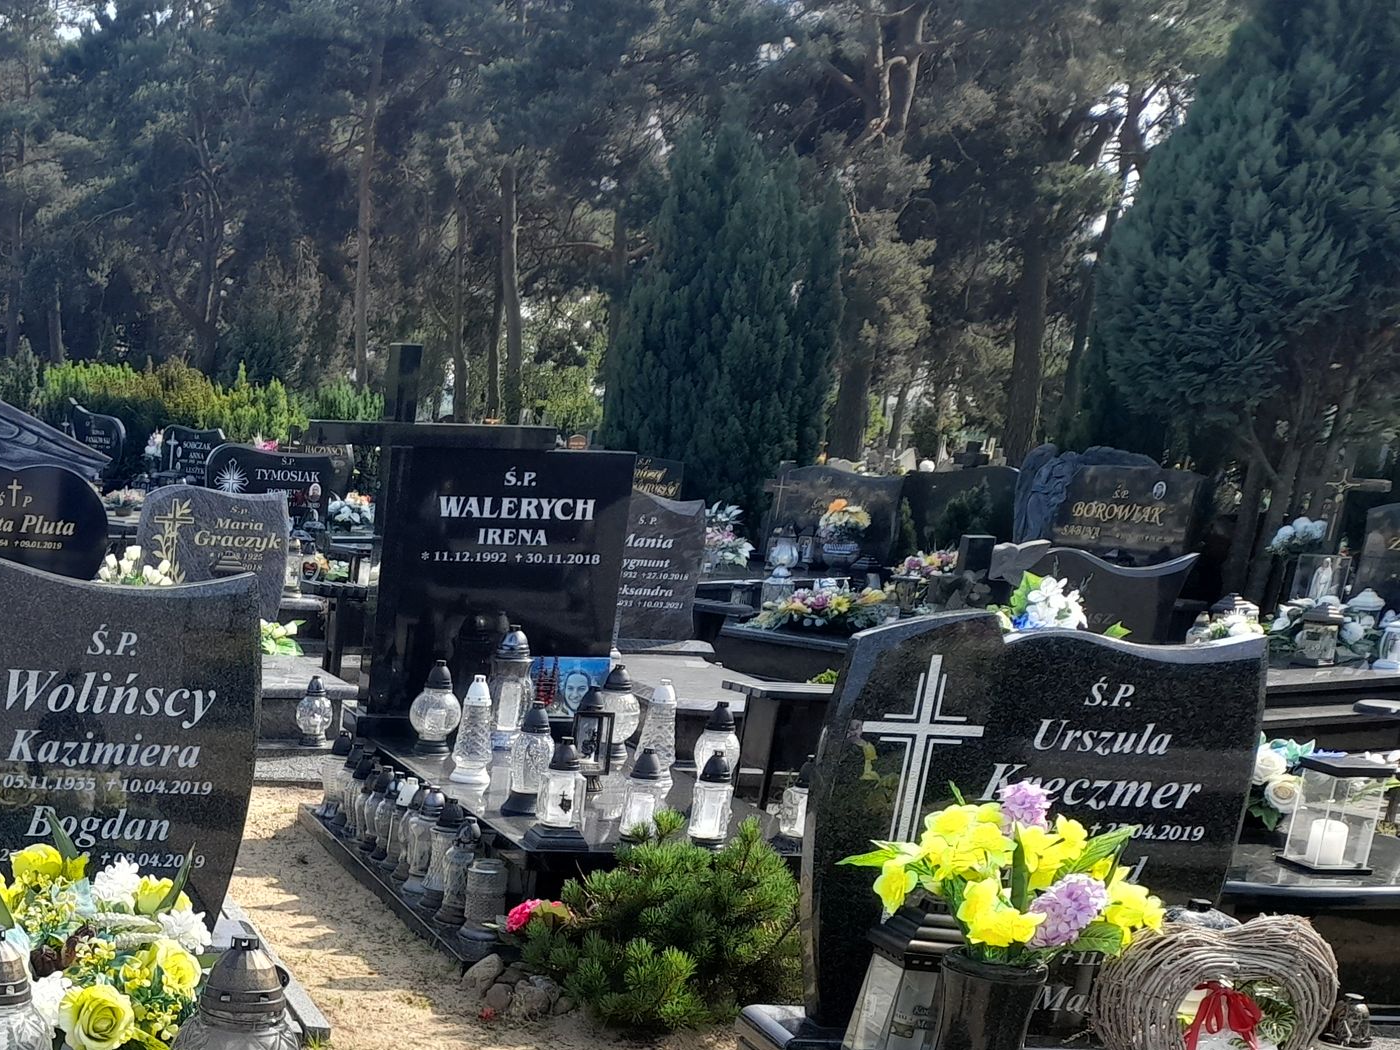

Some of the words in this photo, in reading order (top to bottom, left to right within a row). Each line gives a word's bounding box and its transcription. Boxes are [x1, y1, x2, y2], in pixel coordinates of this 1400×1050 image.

[255, 468, 321, 483] TYMOSIAK
[504, 466, 538, 487] Ś.P.
[22, 496, 32, 507] P
[439, 496, 596, 521] WALERYCH
[215, 518, 264, 531] Maria
[1072, 501, 1166, 526] BOROWIAK
[19, 514, 76, 536] Pluta
[194, 530, 282, 552] Graczyk
[477, 528, 548, 546] IRENA
[434, 551, 507, 563] 11.12.1992
[527, 553, 600, 565] 30.11.2018
[622, 558, 670, 570] ygmunt
[86, 623, 138, 657] Ś.P.
[5, 668, 217, 730] Wolińscy
[1084, 676, 1136, 707] Ś.P.
[1033, 718, 1173, 756] Urszula
[5, 729, 200, 769] Kazimiera
[120, 777, 213, 796] 10.04.2019
[24, 805, 170, 848] Bogdan
